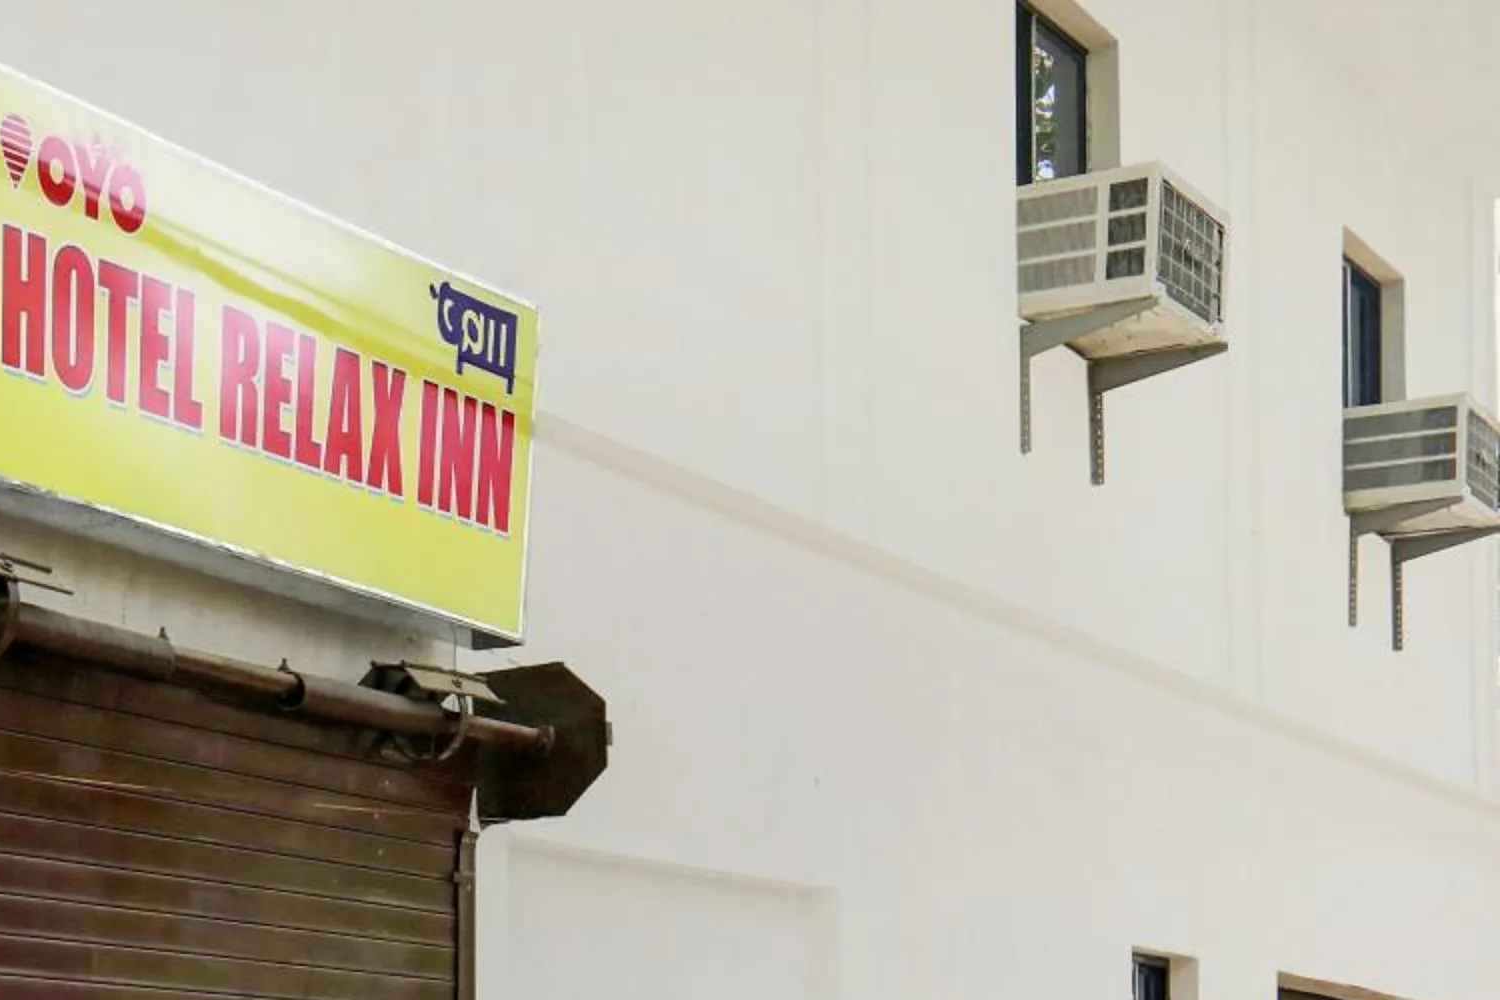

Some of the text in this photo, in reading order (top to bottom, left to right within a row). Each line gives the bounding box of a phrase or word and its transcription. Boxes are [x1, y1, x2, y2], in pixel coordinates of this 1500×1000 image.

[37, 135, 145, 233] OYO
[1, 223, 515, 534] HOTEL RELAX INN
